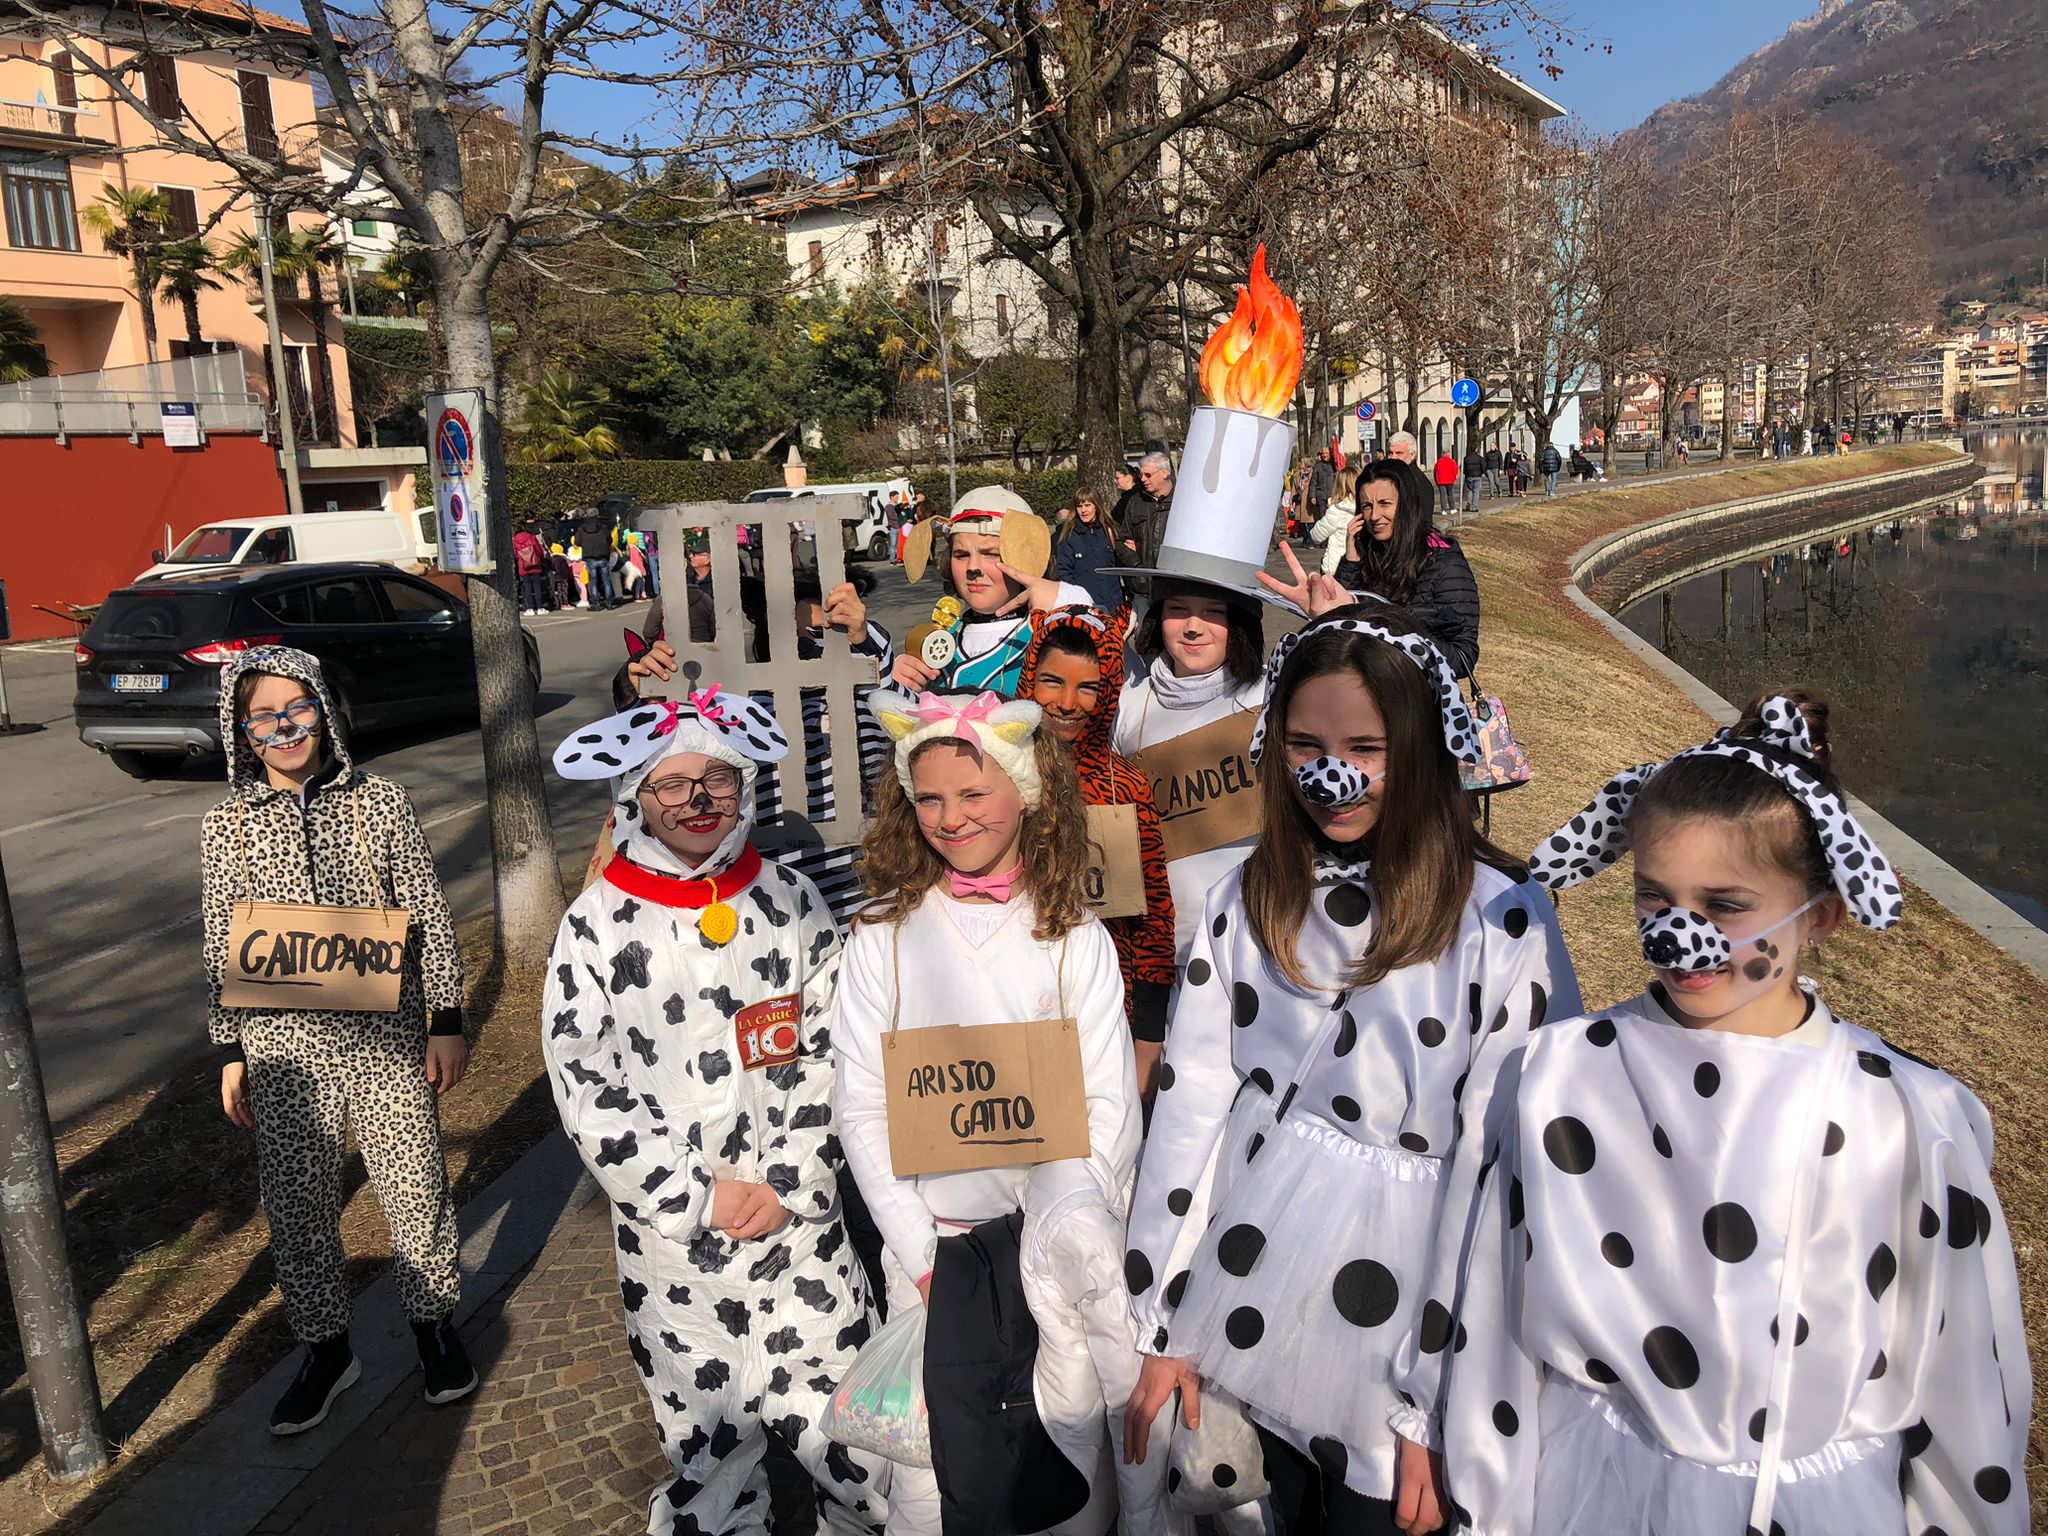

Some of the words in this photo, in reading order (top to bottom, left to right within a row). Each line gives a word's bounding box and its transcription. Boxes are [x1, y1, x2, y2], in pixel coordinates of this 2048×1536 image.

[117, 675, 128, 687] EP
[132, 675, 161, 687] 726XP
[1153, 755, 1254, 817] CANDEL
[239, 929, 405, 977] GATTOPARDO
[743, 1021, 799, 1064] 10
[908, 1060, 996, 1098] ARISTO
[950, 1095, 1035, 1138] GATTO
